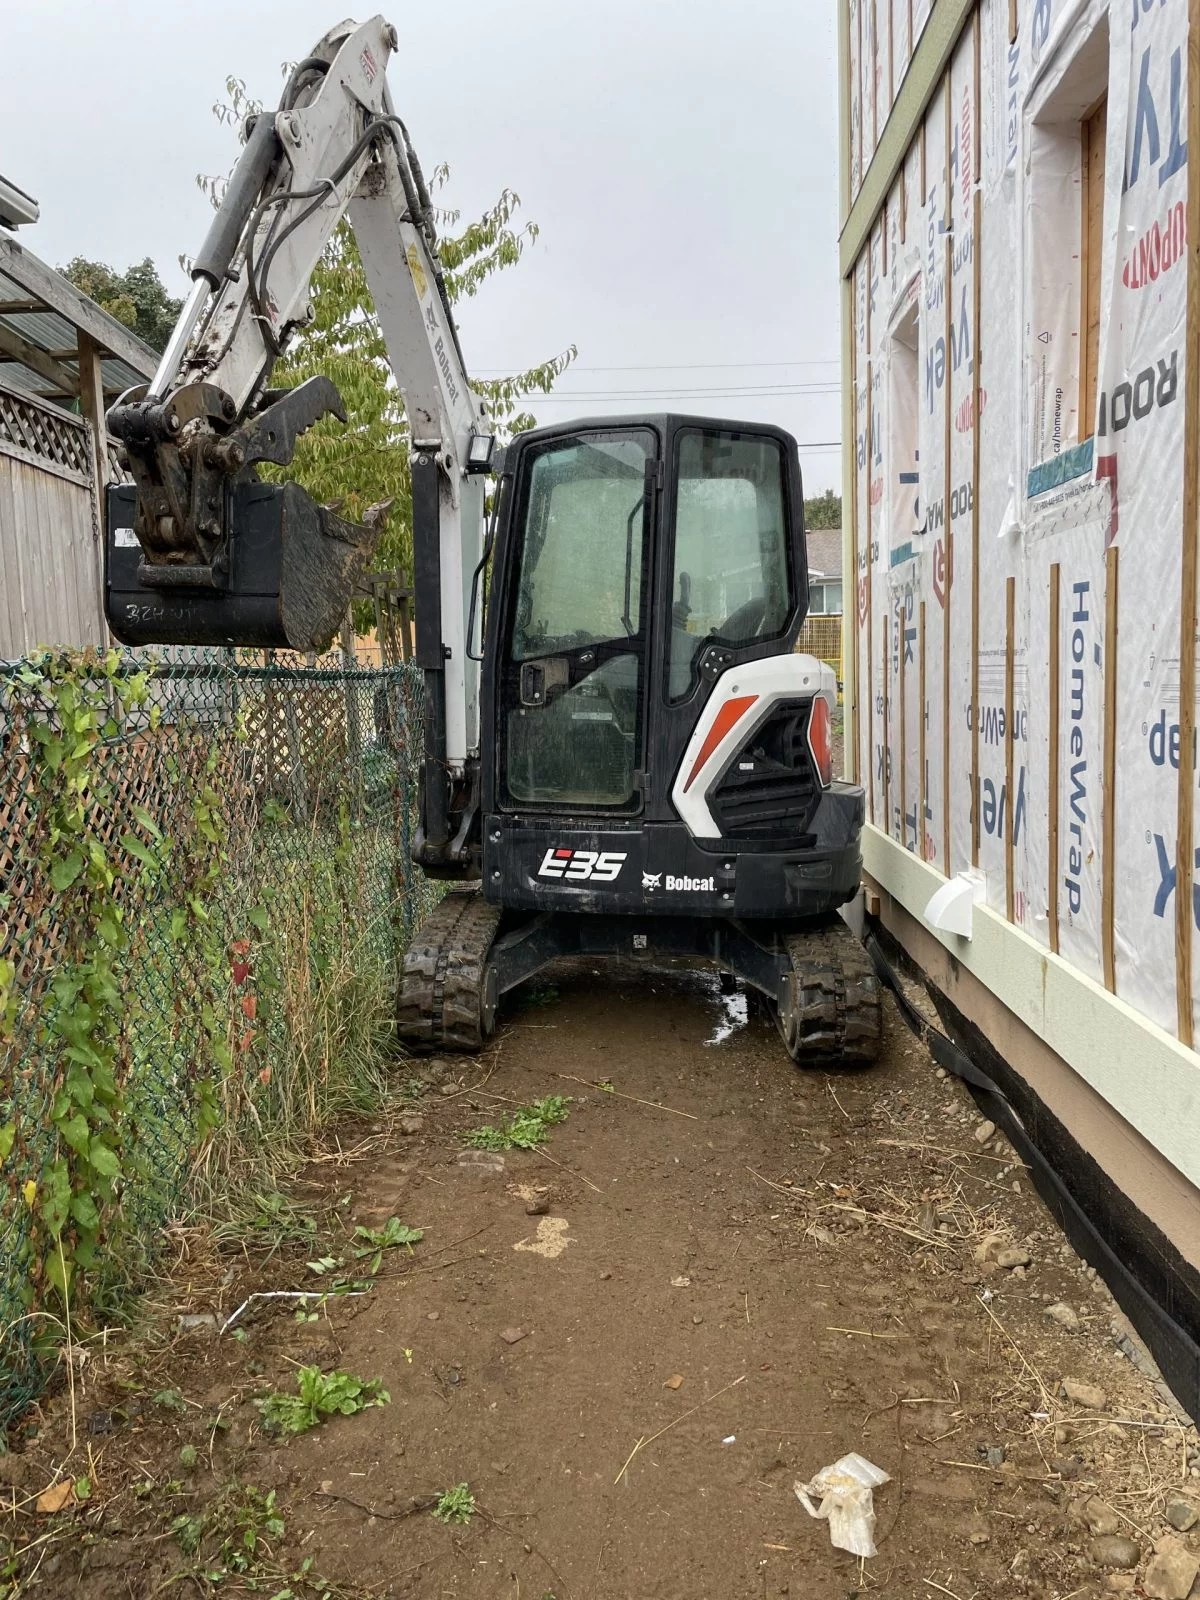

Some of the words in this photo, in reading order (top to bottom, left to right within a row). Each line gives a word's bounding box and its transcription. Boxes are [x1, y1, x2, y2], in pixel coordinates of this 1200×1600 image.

[1122, 200, 1188, 290] UPONT
[435, 336, 459, 407] Bobcat
[1069, 580, 1090, 916] HomeWrap
[538, 848, 628, 881] E35
[665, 875, 714, 891] Bobcat
